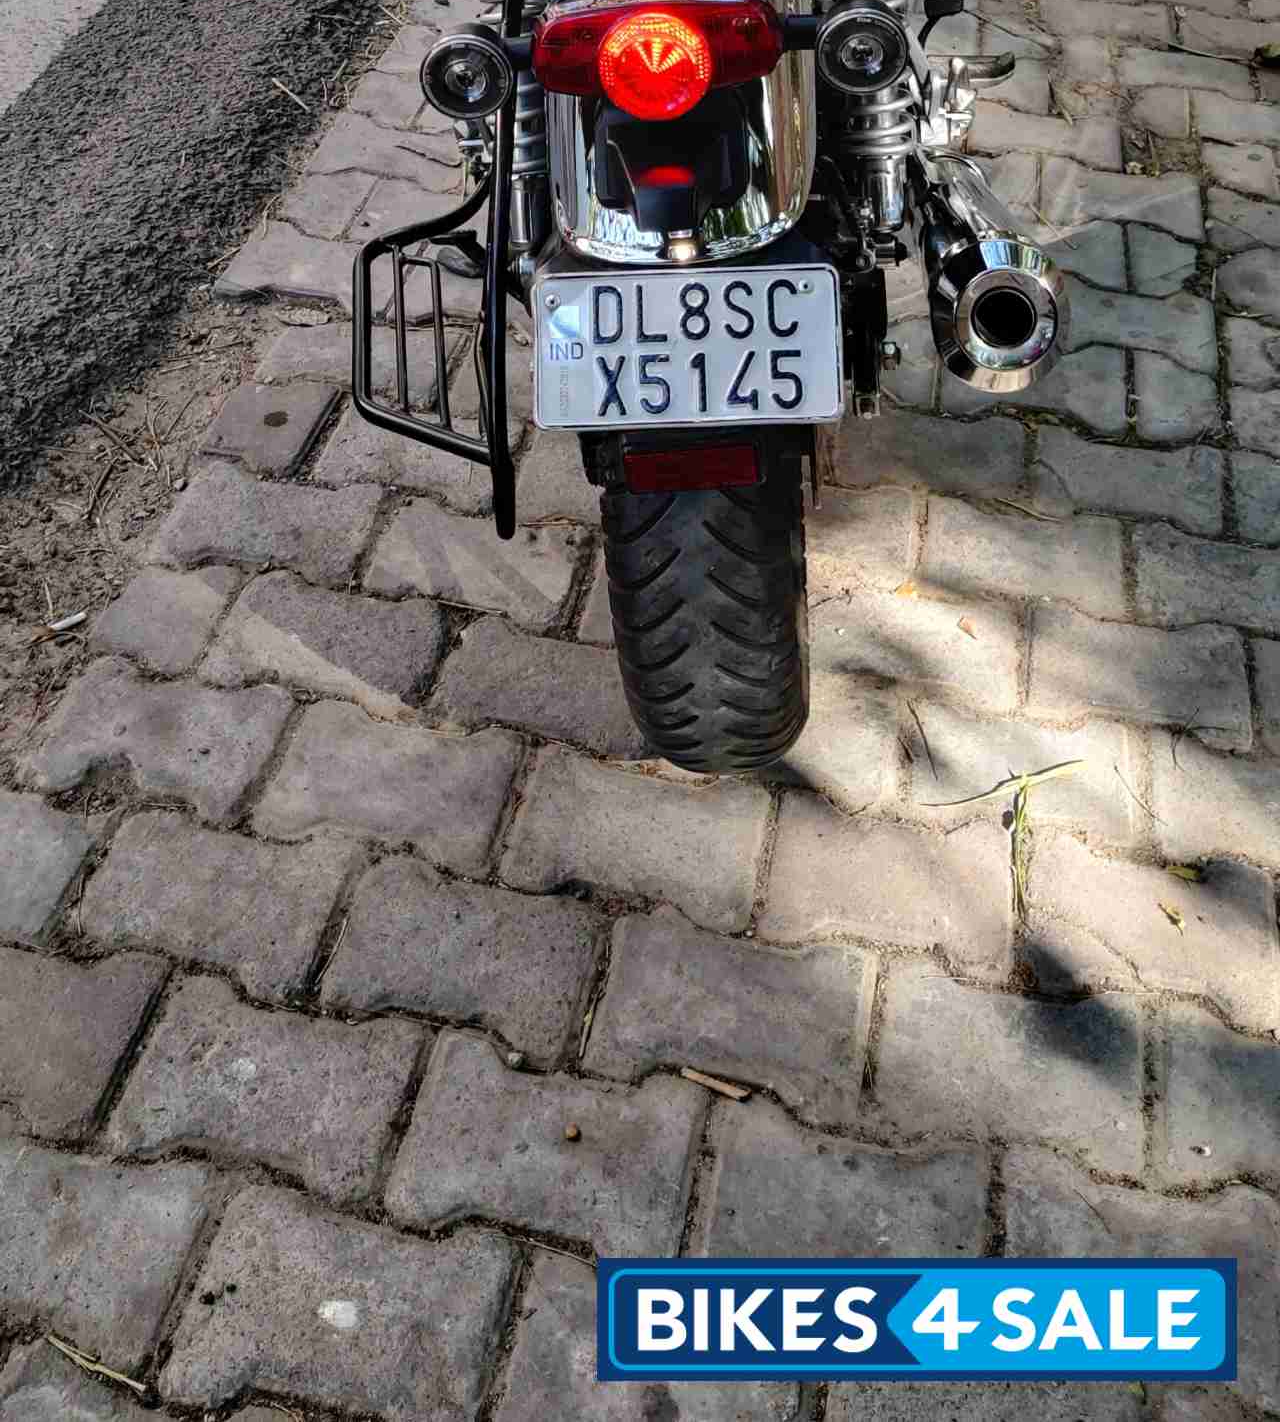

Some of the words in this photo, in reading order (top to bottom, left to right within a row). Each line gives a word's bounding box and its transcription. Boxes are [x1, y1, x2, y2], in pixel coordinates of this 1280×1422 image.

[592, 280, 799, 345] DL8SC
[549, 342, 584, 361] IND
[597, 349, 804, 417] X5145
